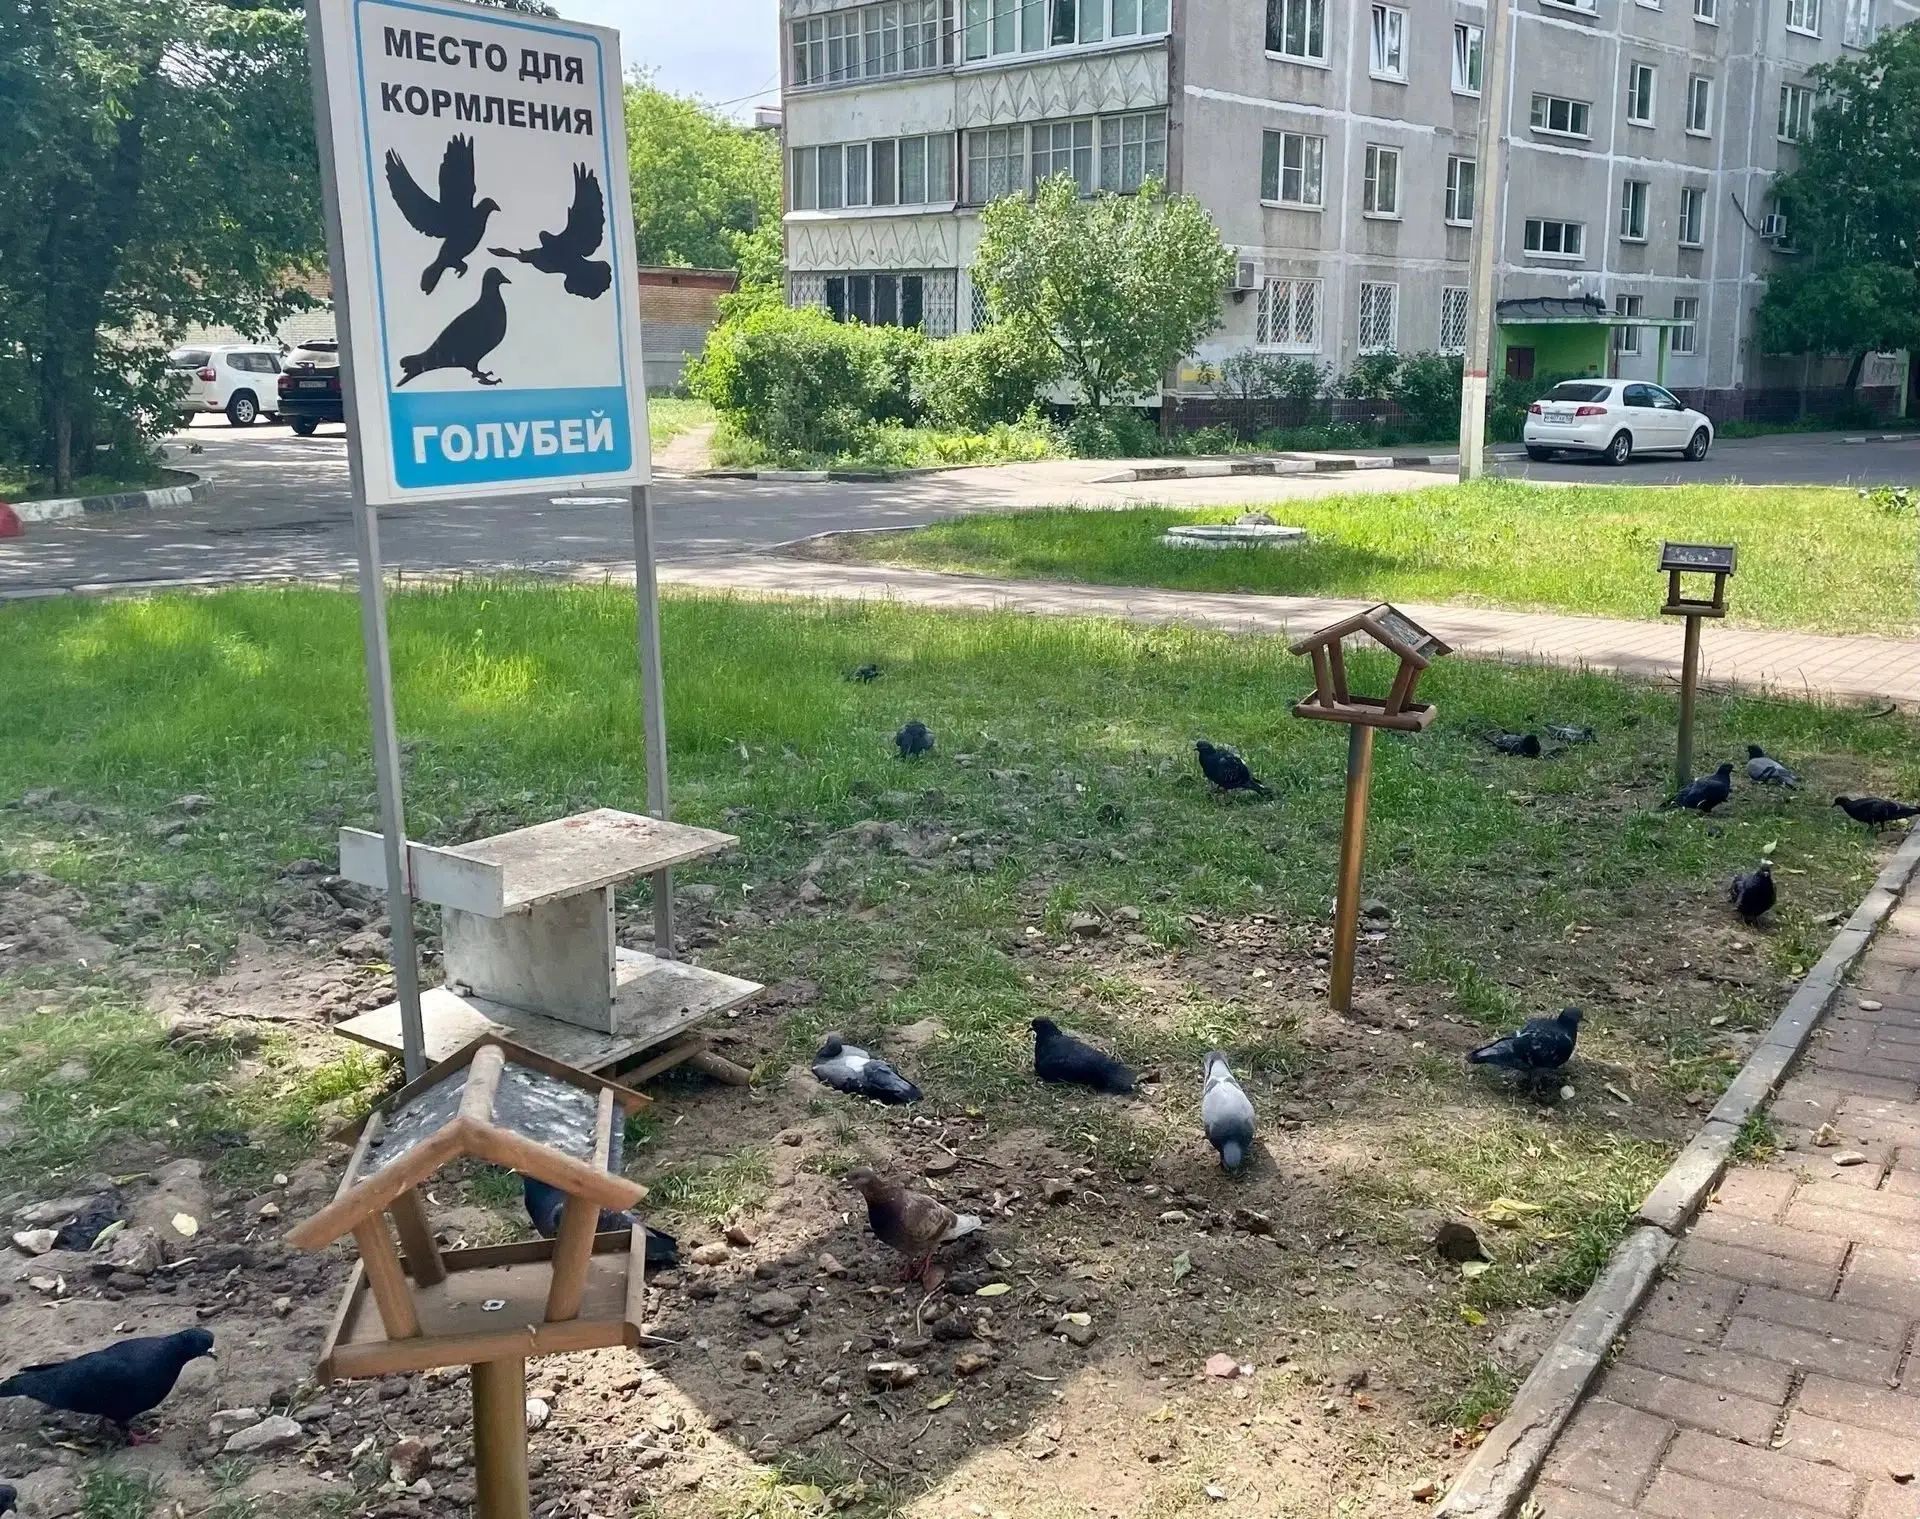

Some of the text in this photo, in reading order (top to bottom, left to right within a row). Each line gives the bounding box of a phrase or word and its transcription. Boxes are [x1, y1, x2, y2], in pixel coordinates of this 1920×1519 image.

[384, 27, 584, 84] МЕСТО ДЛЯ
[381, 82, 593, 136] КОРМЛЕНИЯ
[413, 410, 614, 464] ГОЛУБЕЙ
